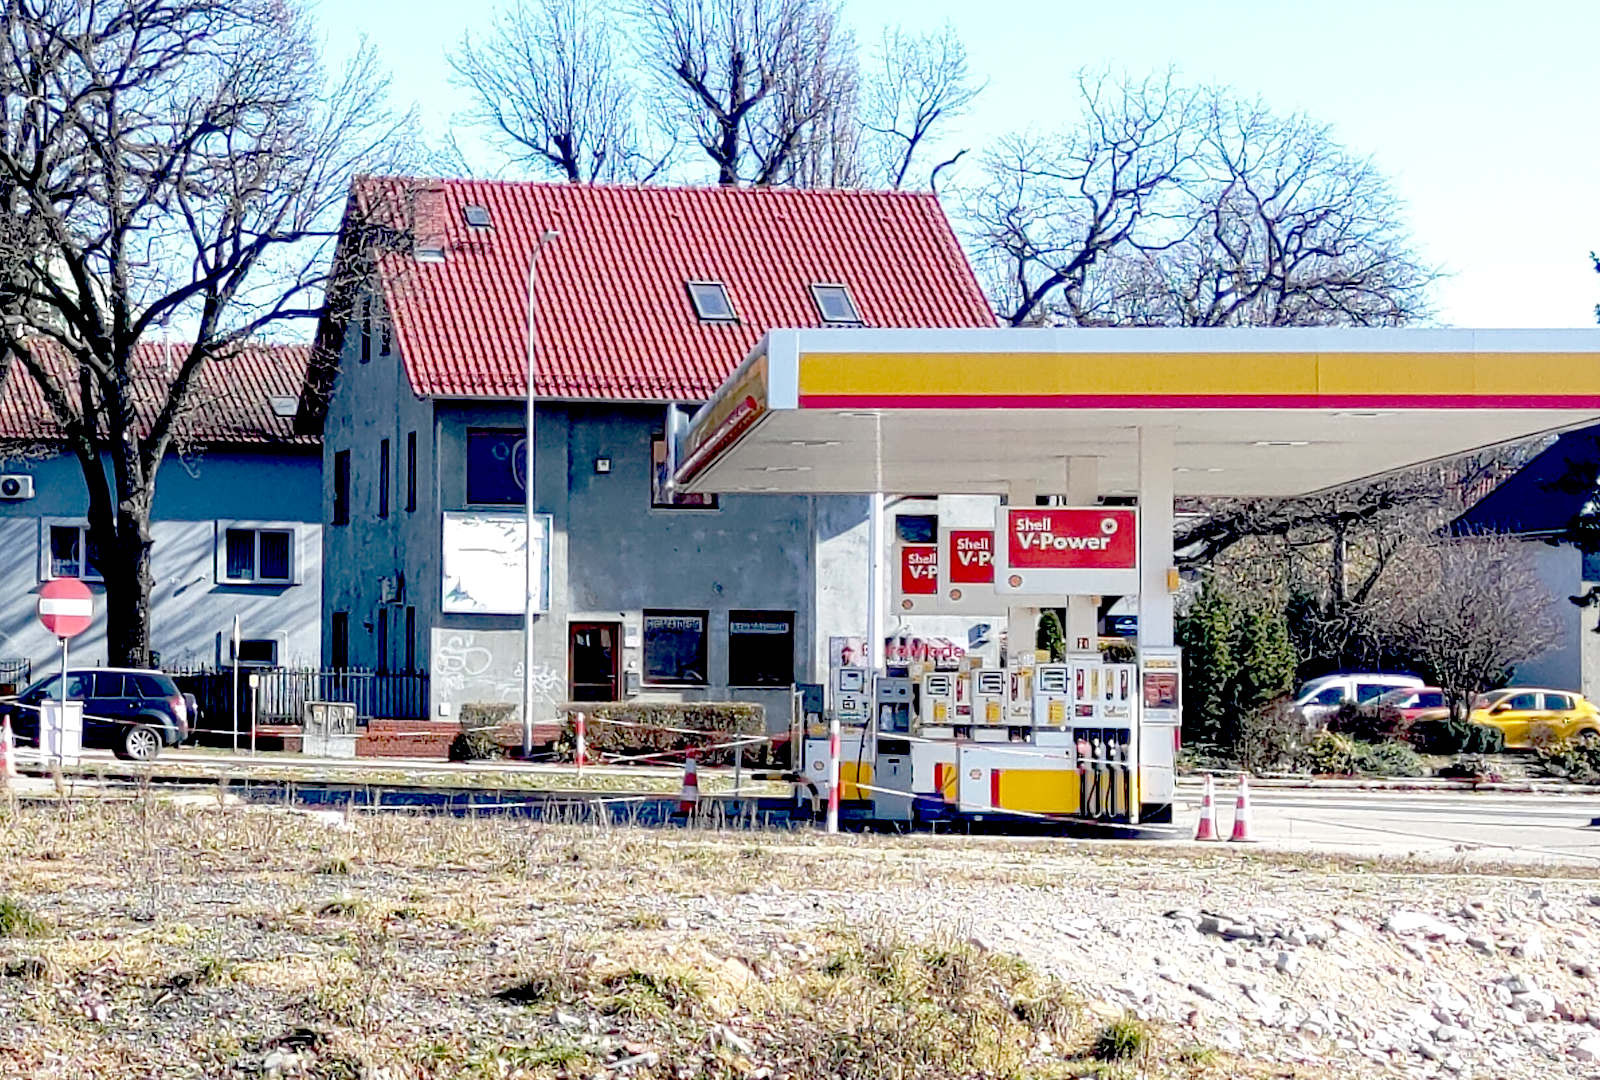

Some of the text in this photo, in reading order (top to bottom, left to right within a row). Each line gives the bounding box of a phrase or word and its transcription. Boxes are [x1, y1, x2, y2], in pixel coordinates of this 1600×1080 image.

[1016, 517, 1051, 531] Shell
[956, 537, 989, 550] Shell
[1016, 532, 1111, 550] V-Power
[908, 552, 937, 565] Shell
